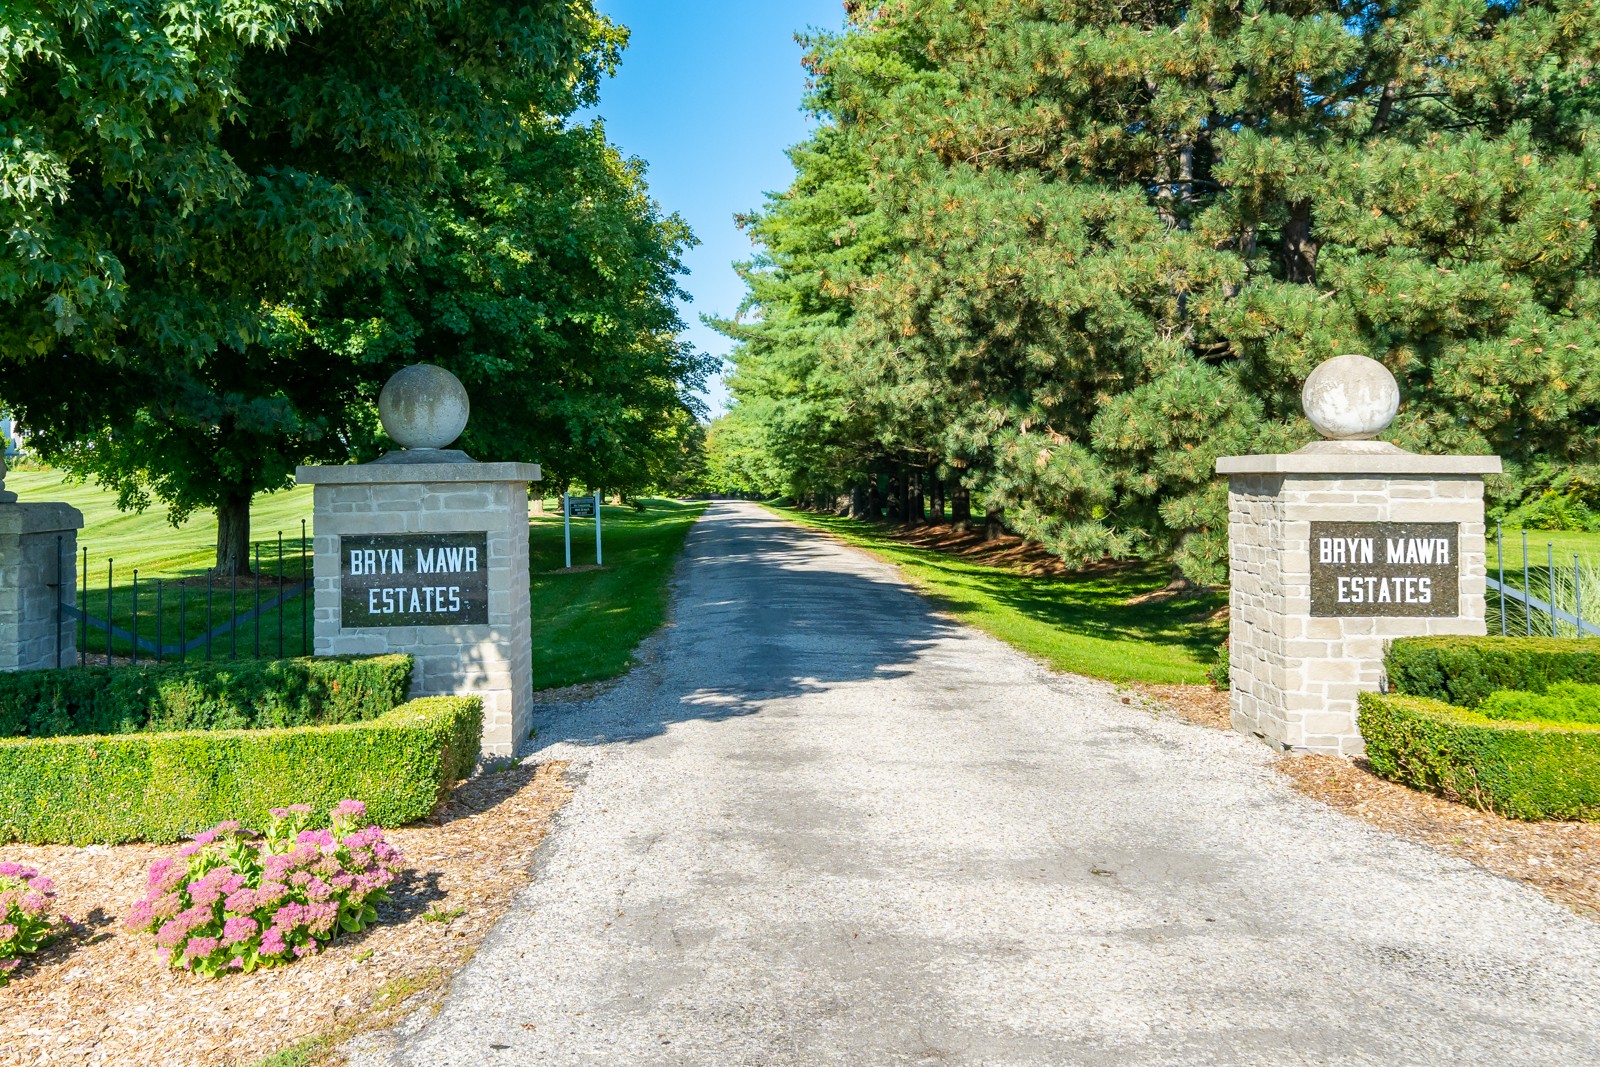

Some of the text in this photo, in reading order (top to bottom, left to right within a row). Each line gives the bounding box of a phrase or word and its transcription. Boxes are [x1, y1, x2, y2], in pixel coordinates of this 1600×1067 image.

[350, 547, 478, 575] BRYN MAWR
[1319, 538, 1449, 564] BRYN MAWR
[368, 587, 460, 613] ESTATES
[1337, 577, 1431, 603] ESTATES
